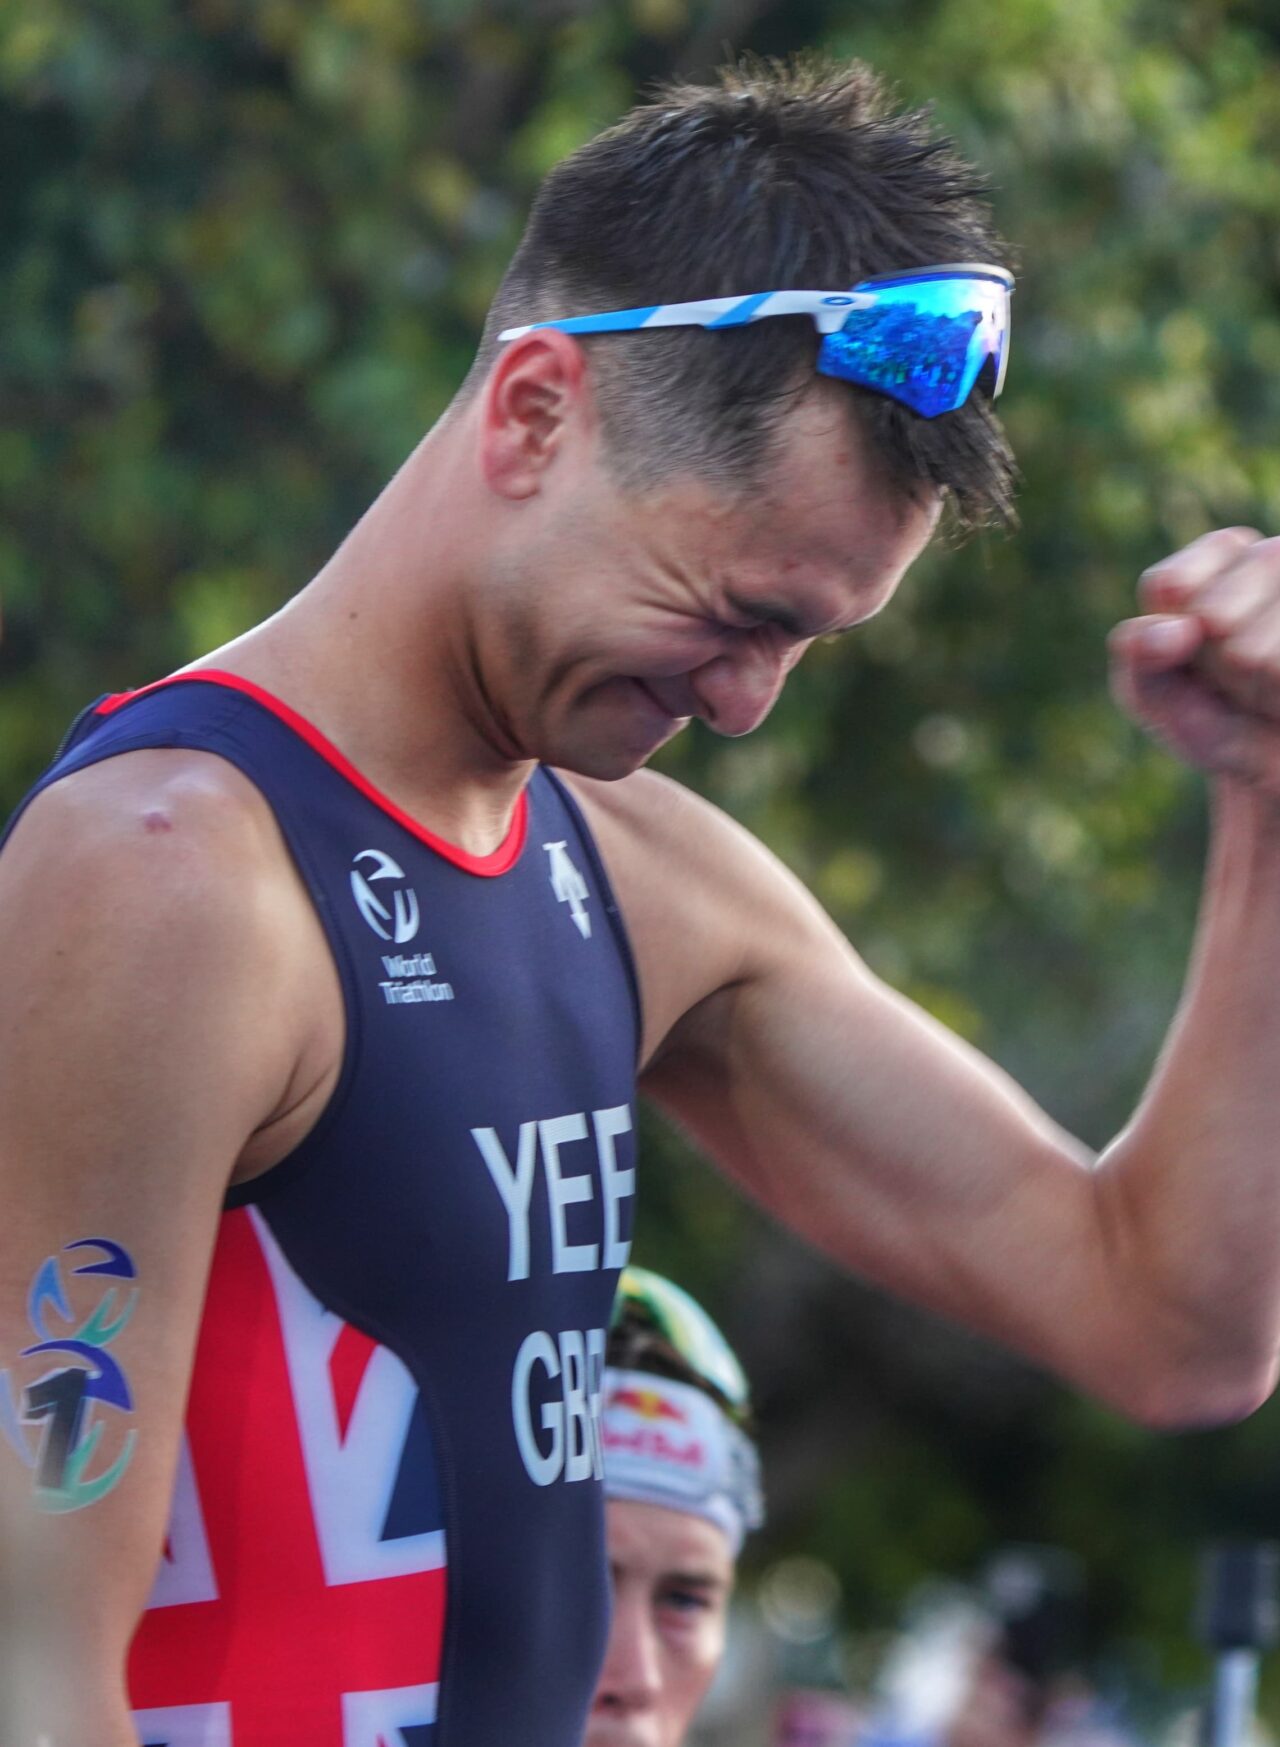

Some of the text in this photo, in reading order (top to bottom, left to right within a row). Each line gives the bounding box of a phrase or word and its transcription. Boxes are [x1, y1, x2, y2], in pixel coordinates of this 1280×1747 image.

[377, 979, 455, 1004] Triathlon
[381, 952, 437, 978] World
[470, 1103, 636, 1281] YEE
[24, 1367, 90, 1490] 1
